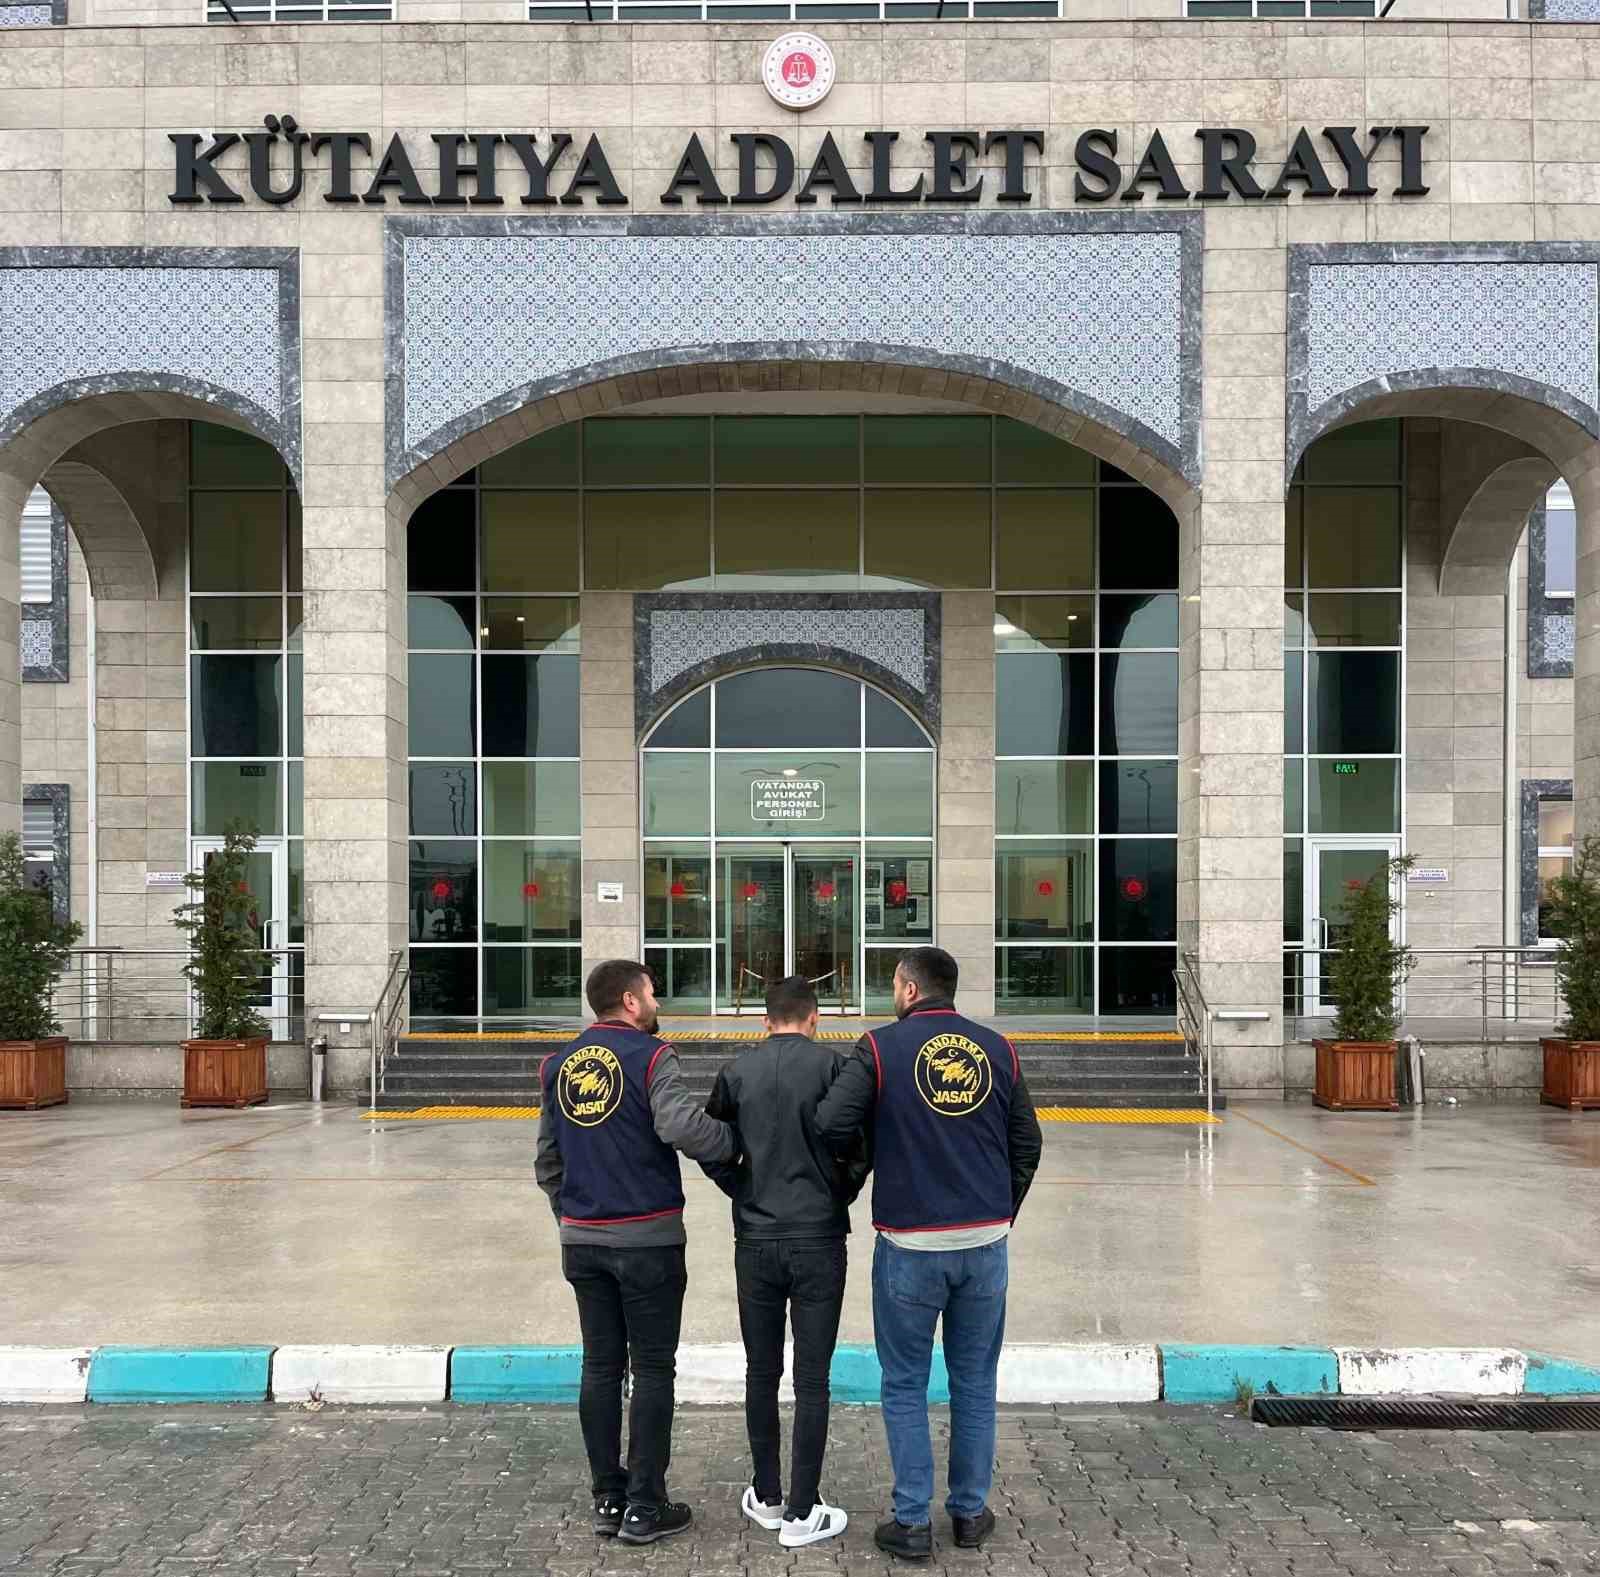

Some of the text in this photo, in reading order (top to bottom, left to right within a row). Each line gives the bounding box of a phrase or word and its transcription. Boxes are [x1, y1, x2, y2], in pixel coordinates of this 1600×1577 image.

[167, 114, 1431, 206] KÜTAHYA ADALET SARAYI
[756, 782, 820, 791] VATANDAŞ
[763, 791, 813, 799] AVUKAT
[756, 800, 820, 808] PERSONEL
[922, 1036, 984, 1063] JANDARMA
[563, 1047, 617, 1076] JANDARMA
[933, 1090, 976, 1104] JASAT
[573, 1100, 607, 1116] JASAT
